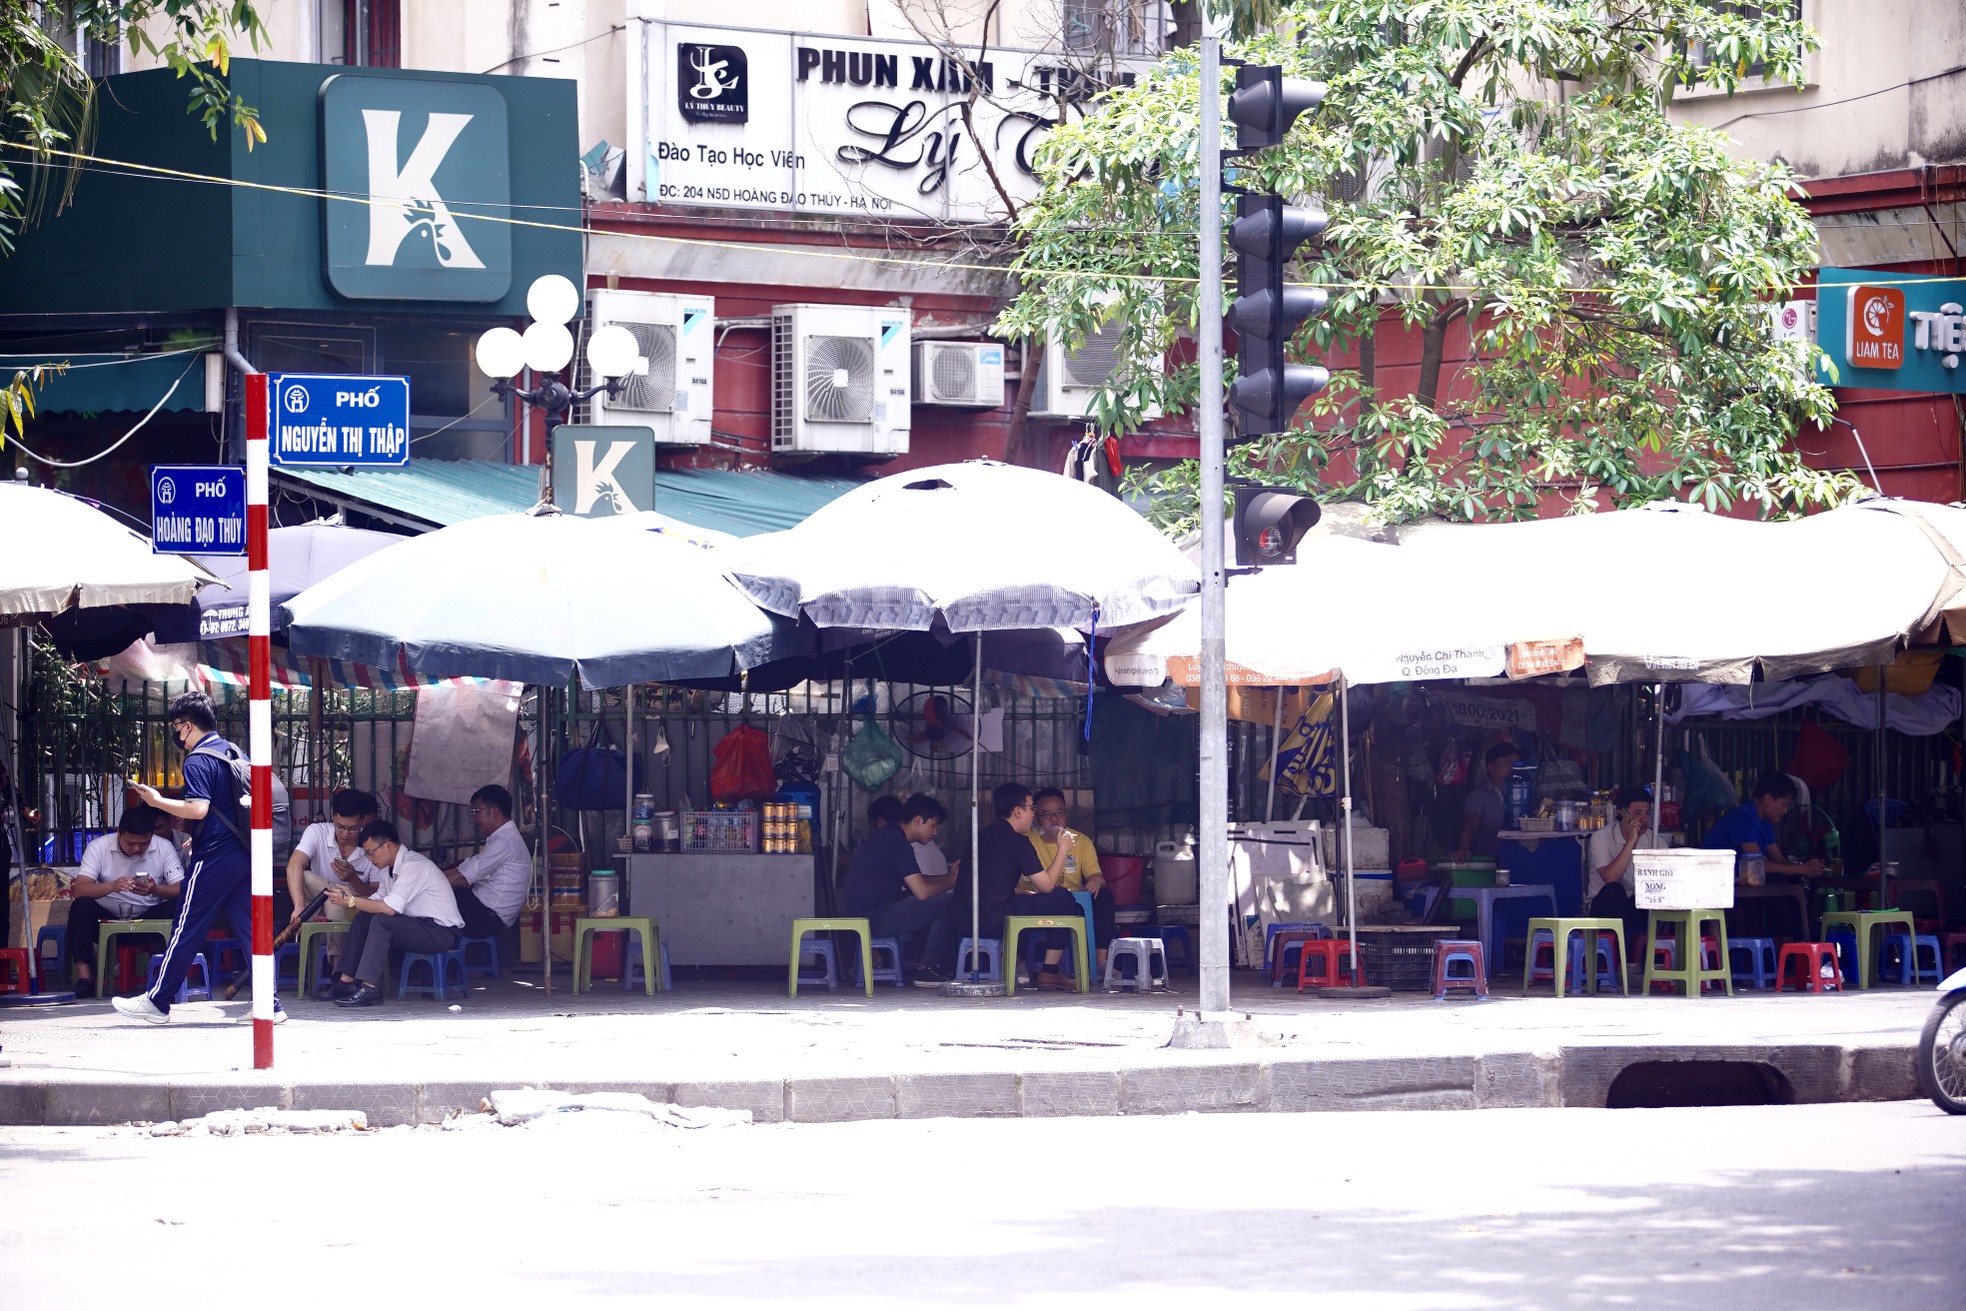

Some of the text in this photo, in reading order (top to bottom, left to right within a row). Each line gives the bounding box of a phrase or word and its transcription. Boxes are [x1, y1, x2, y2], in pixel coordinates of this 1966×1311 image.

[797, 47, 898, 87] PHUN
[716, 104, 745, 112] BEAUTY
[658, 141, 690, 161] Đào
[697, 145, 727, 167] Tạo
[733, 147, 764, 170] Học
[836, 100, 962, 195] Lý
[361, 109, 487, 269] K
[659, 185, 680, 197] ĐC:
[683, 185, 704, 198] 204
[707, 188, 730, 200] N5D
[733, 187, 777, 204] HOÀNG
[810, 192, 841, 207] THÚY
[1856, 341, 1899, 360] LIAM TEA
[1909, 302, 1966, 369] TIỆ
[336, 386, 381, 407] PHỐ
[281, 417, 405, 458] NGUYỄN THỊ THẬP
[195, 475, 226, 498] PHỐ
[574, 440, 641, 514] K
[156, 511, 242, 547] HOÀNG ĐẠO THÚY
